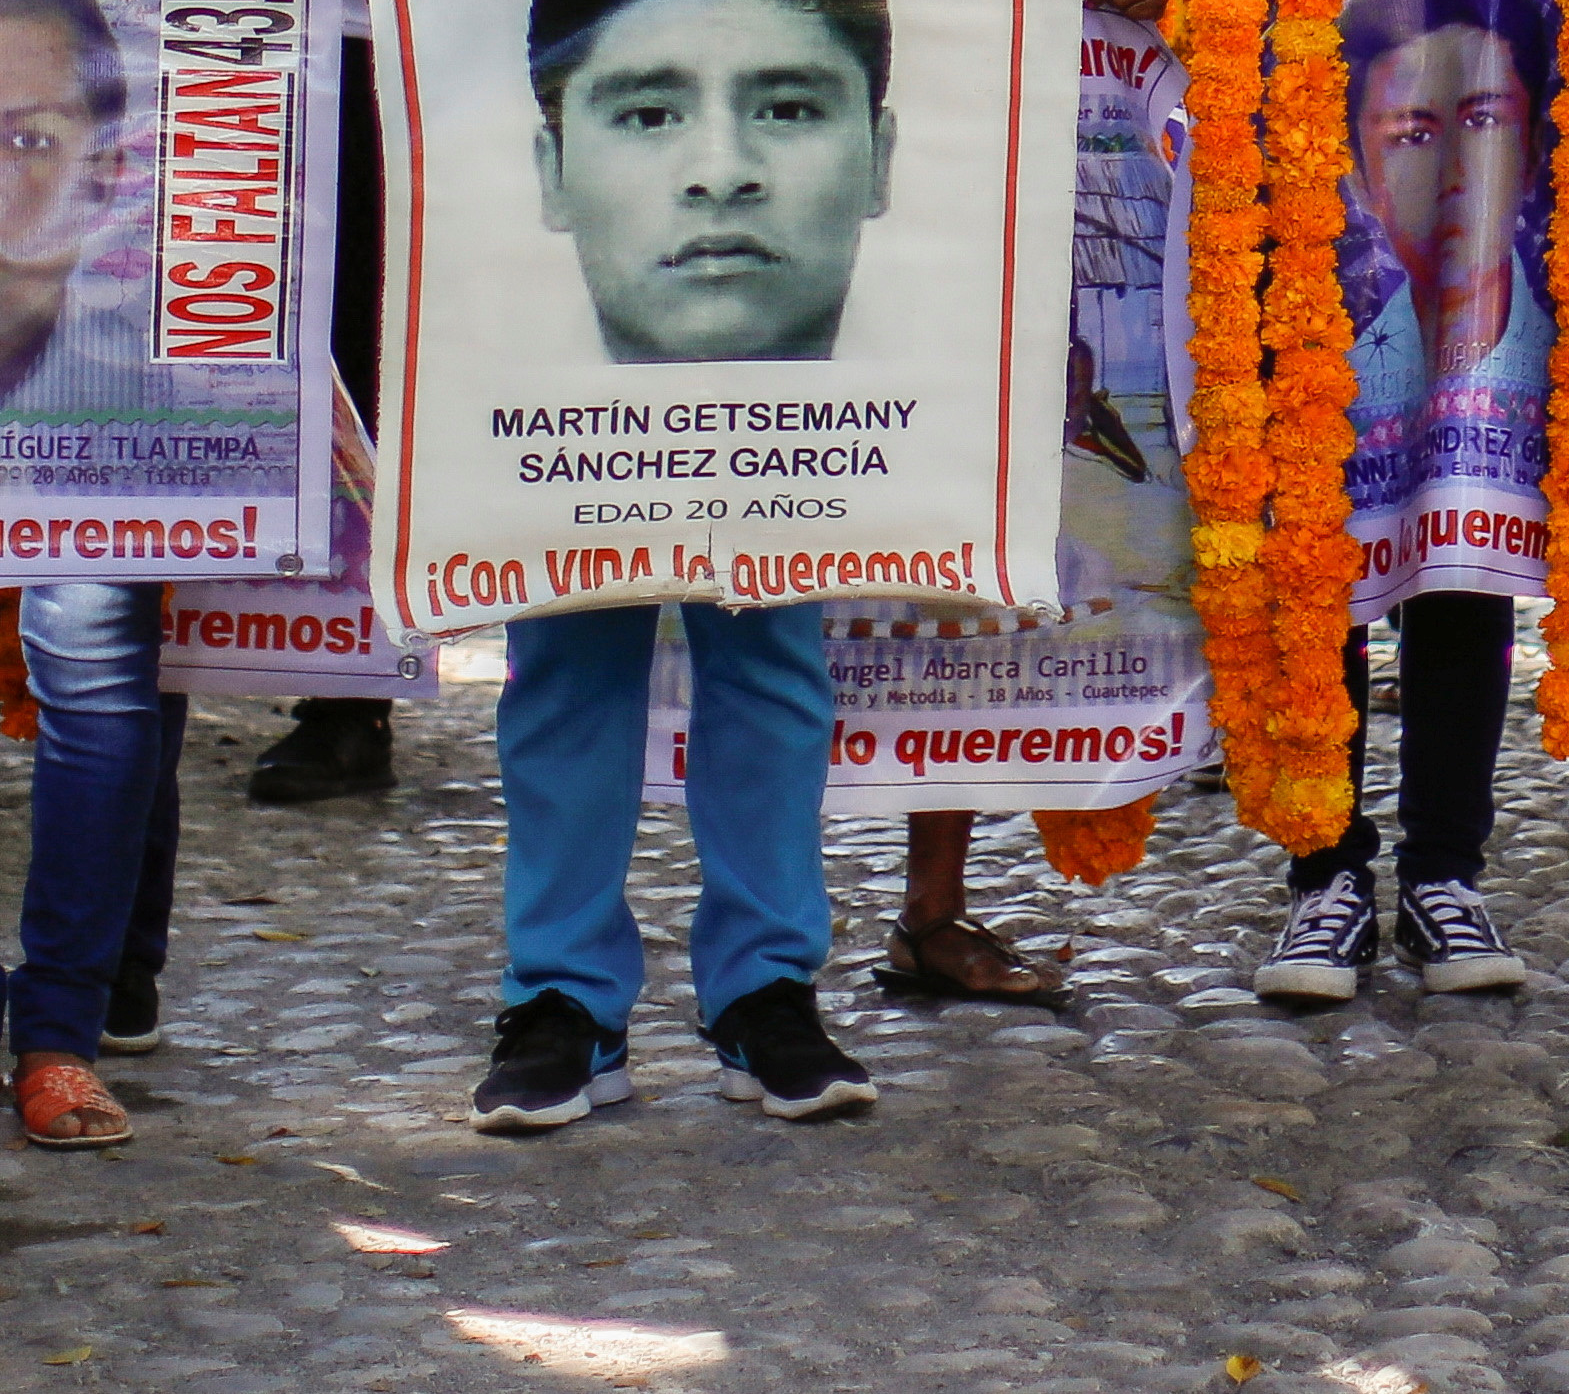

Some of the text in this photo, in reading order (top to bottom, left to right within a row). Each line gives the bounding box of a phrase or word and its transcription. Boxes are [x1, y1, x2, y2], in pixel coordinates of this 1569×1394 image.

[171, 69, 281, 243] FALTAN
[166, 261, 275, 358] NOS
[491, 400, 916, 438] MARTÍN GETSEMANY
[114, 436, 259, 462] TLATEMPA
[518, 441, 888, 484] SÁNCHEZ GARCÍA
[33, 467, 55, 484] 20
[65, 465, 110, 484] Años
[573, 495, 847, 524] EDAD 20 AÑOS
[428, 552, 526, 618] ¡Con
[545, 547, 651, 596] VIDA
[733, 542, 975, 601] queremos!
[924, 654, 1020, 681] Abarca
[1037, 652, 1148, 678] Carillo
[887, 687, 957, 705] Metodia
[988, 685, 1007, 702] 18
[1017, 683, 1054, 702] Años
[1082, 681, 1169, 702] Cuautepec
[832, 712, 1185, 779] lo queremos!
